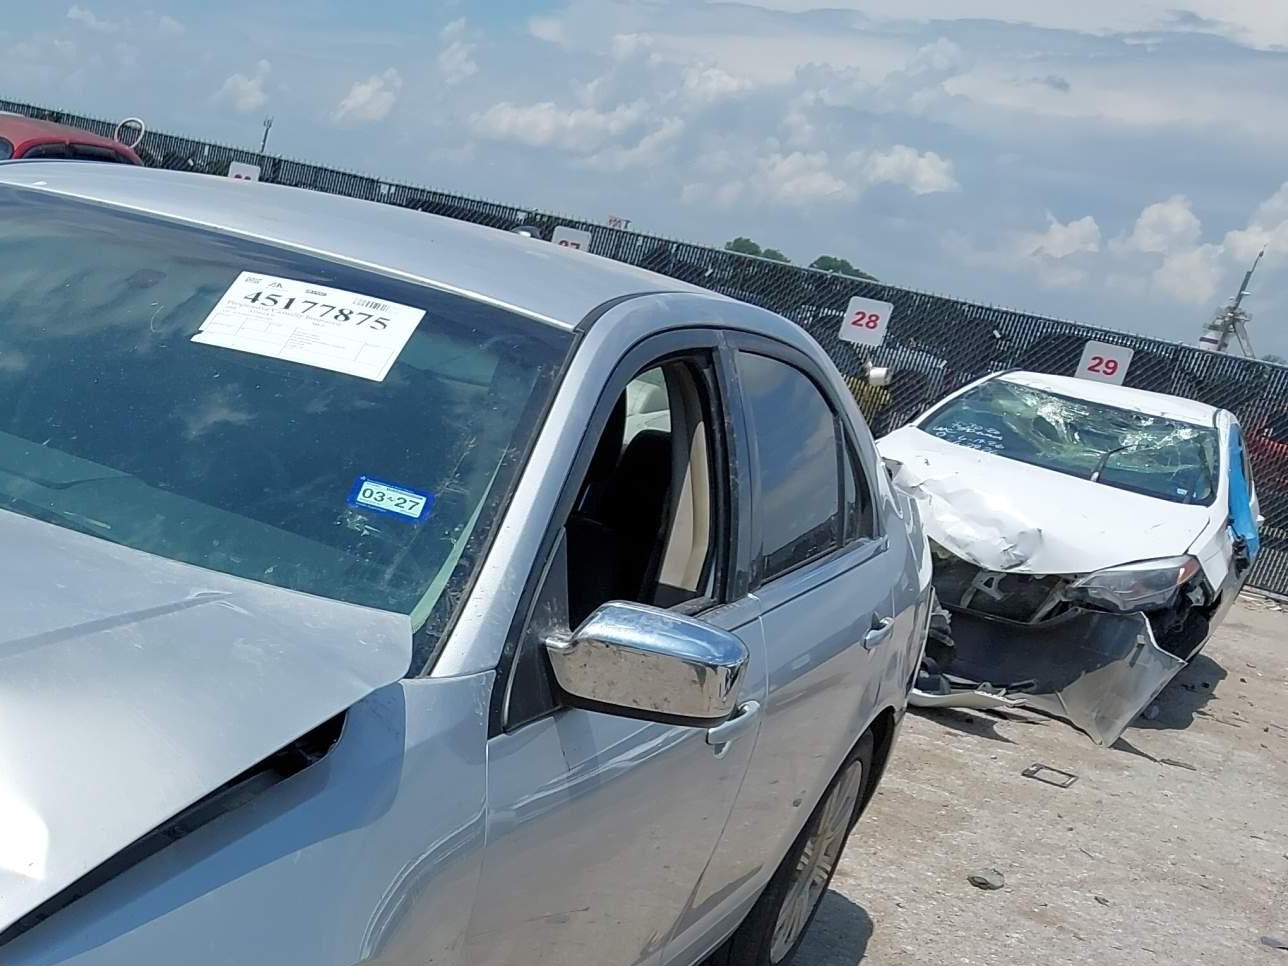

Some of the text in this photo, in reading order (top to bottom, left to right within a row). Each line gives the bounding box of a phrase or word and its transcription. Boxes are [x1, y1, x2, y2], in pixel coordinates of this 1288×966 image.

[244, 290, 391, 331] 45177875
[851, 311, 880, 330] 28
[1087, 356, 1118, 376] 29
